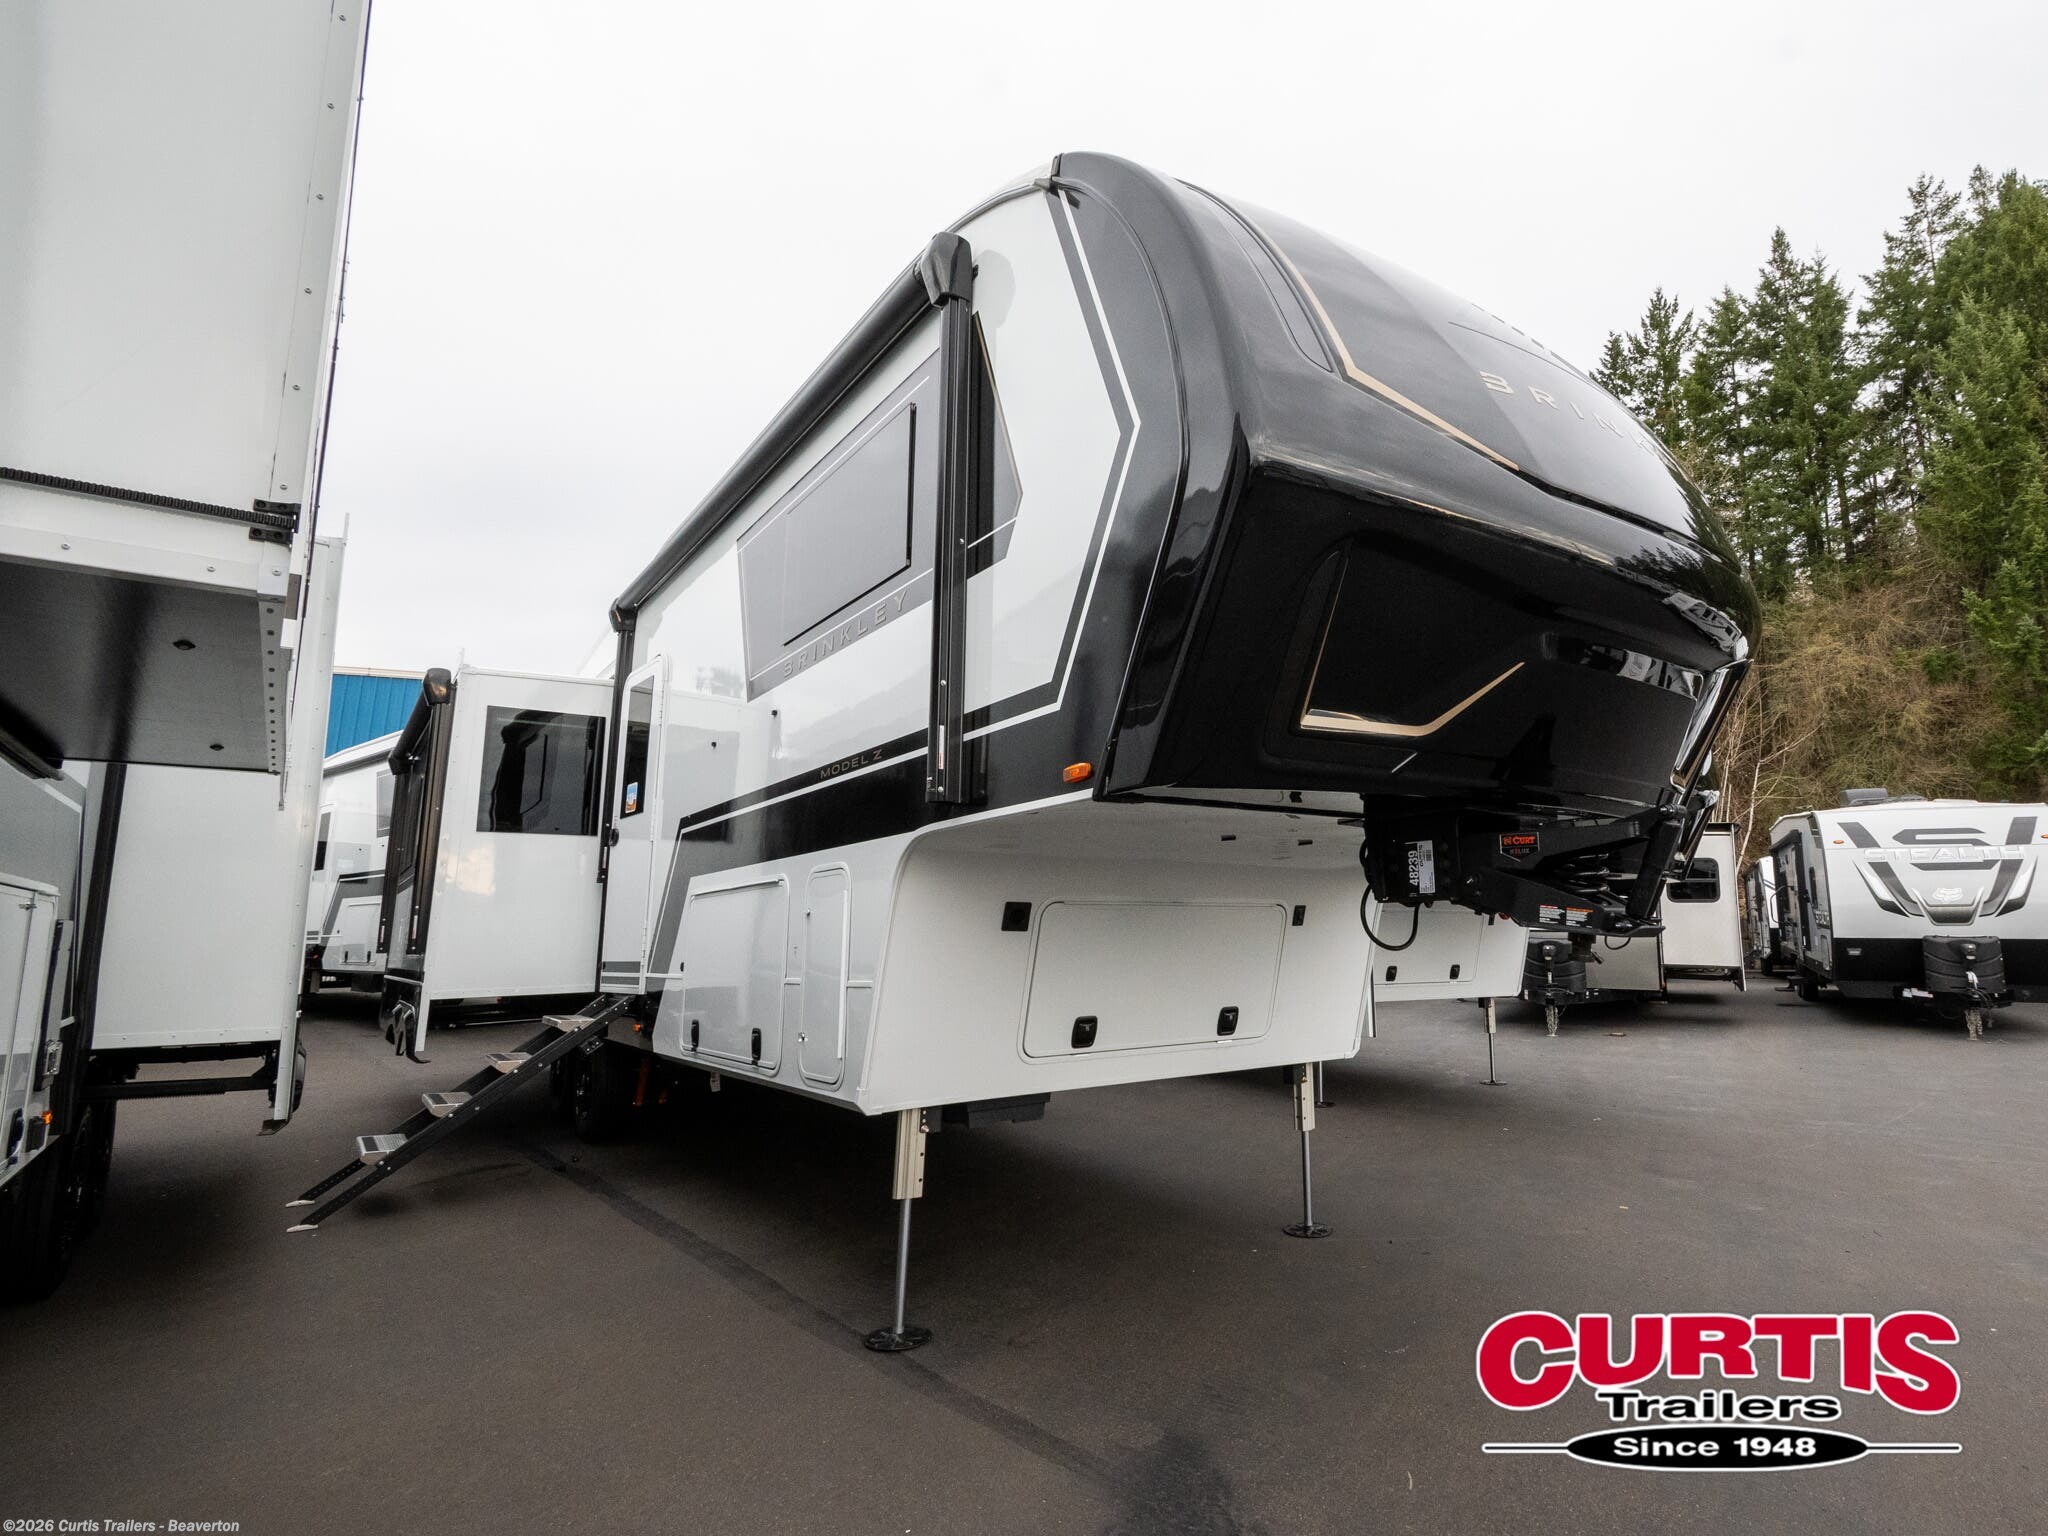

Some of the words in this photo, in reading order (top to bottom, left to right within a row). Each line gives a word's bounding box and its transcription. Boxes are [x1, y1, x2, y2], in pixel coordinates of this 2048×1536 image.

[783, 589, 908, 679] BRINKLEY
[819, 755, 869, 779] MODEL
[872, 749, 883, 760] Z
[1512, 835, 1536, 845] CURT
[1863, 844, 2026, 863] STEALTH
[1407, 850, 1419, 887] 48239
